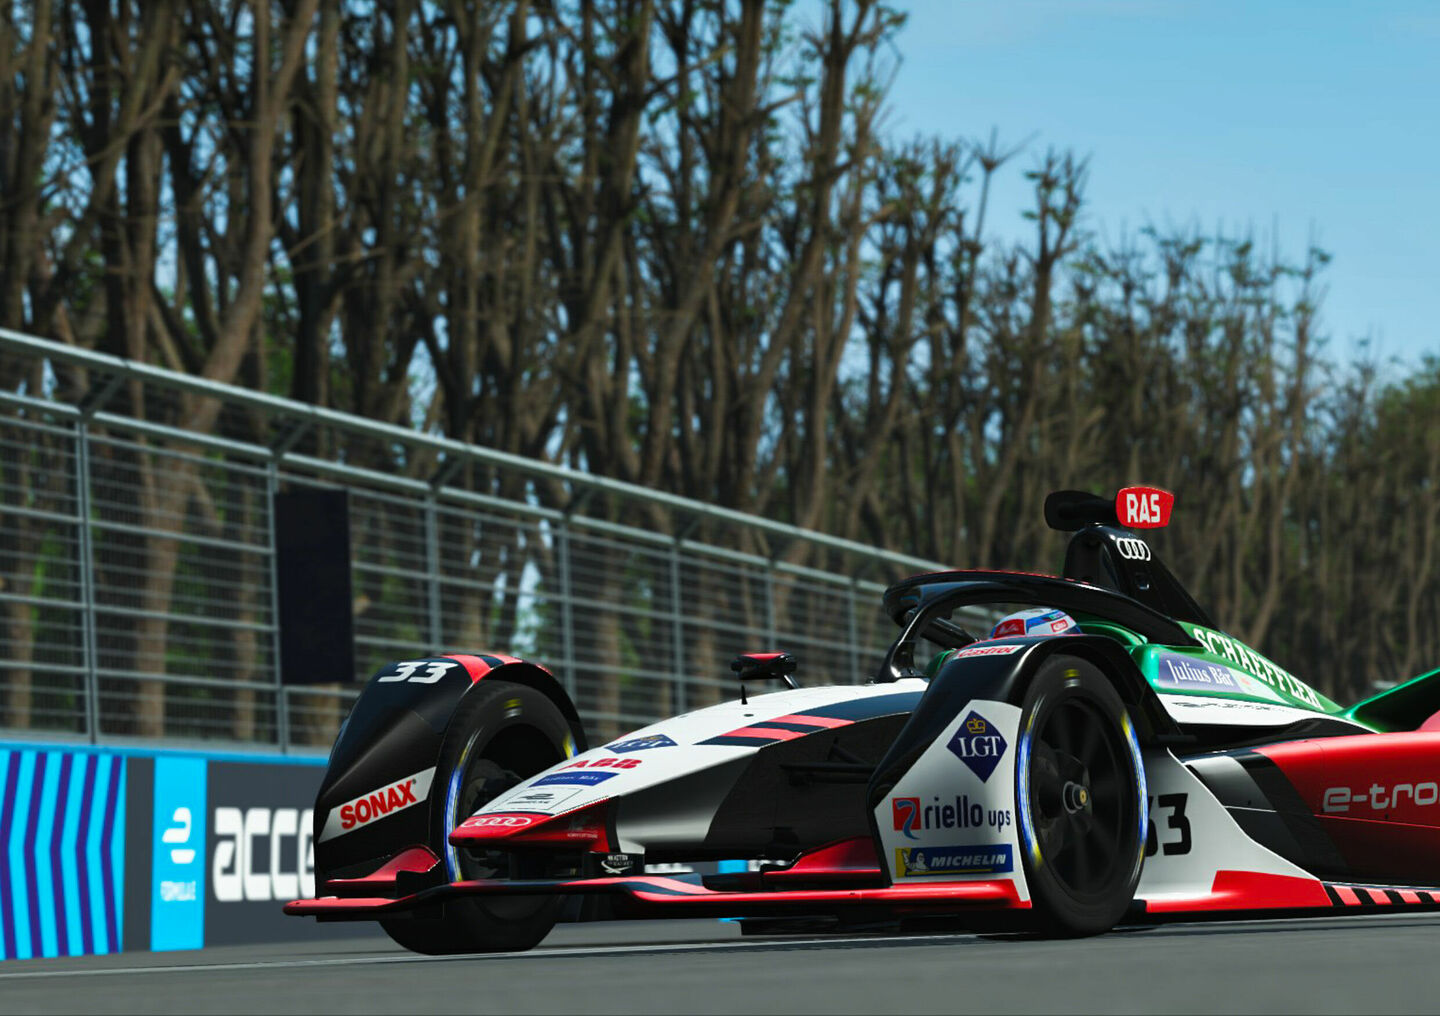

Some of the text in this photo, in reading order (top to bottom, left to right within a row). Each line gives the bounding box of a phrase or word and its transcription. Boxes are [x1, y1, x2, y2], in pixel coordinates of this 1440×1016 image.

[377, 661, 459, 684] 33
[1166, 659, 1235, 687] Julius Bär
[1193, 627, 1325, 712] SCHAEFFLER
[958, 735, 1000, 758] LGT
[553, 757, 643, 772] ABB
[340, 779, 417, 830] SONAX
[924, 794, 1012, 833] riello ups
[931, 854, 1007, 868] MICHELIN
